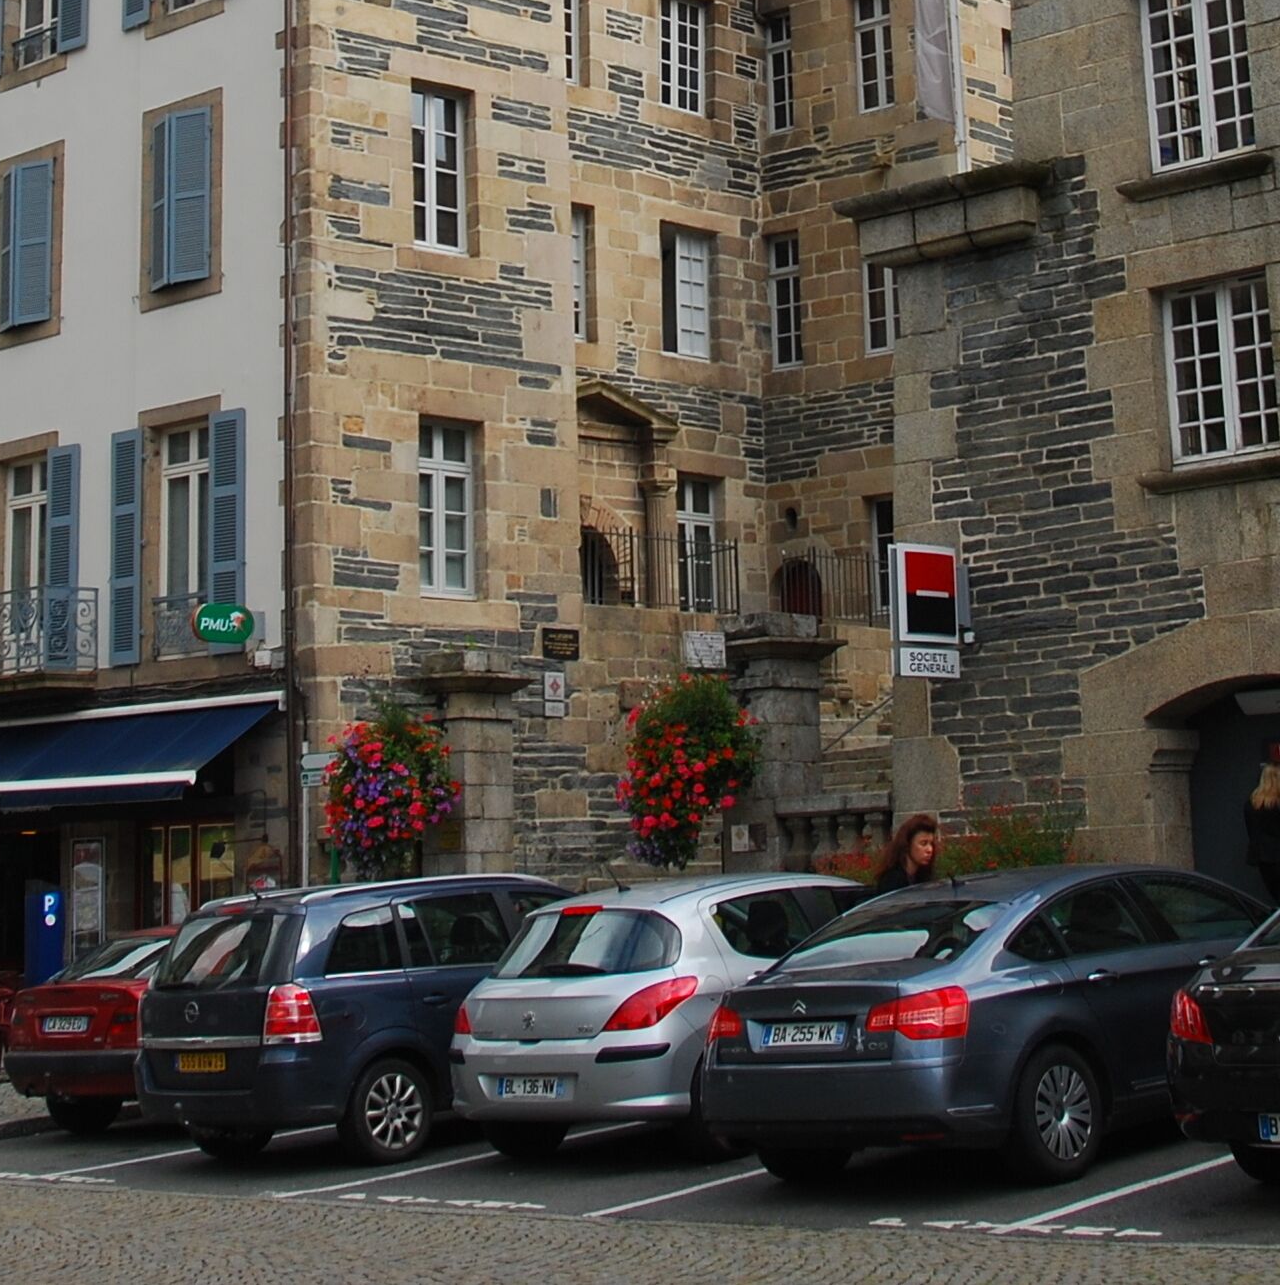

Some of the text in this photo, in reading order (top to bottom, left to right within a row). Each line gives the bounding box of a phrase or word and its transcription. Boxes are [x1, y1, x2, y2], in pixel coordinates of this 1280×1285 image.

[200, 617, 229, 631] PMU
[909, 652, 948, 664] SOCIETE
[909, 663, 956, 674] GENERALE
[44, 894, 55, 912] P
[772, 1023, 835, 1044] BA-255-WK
[504, 1078, 555, 1095] BL-136-NW
